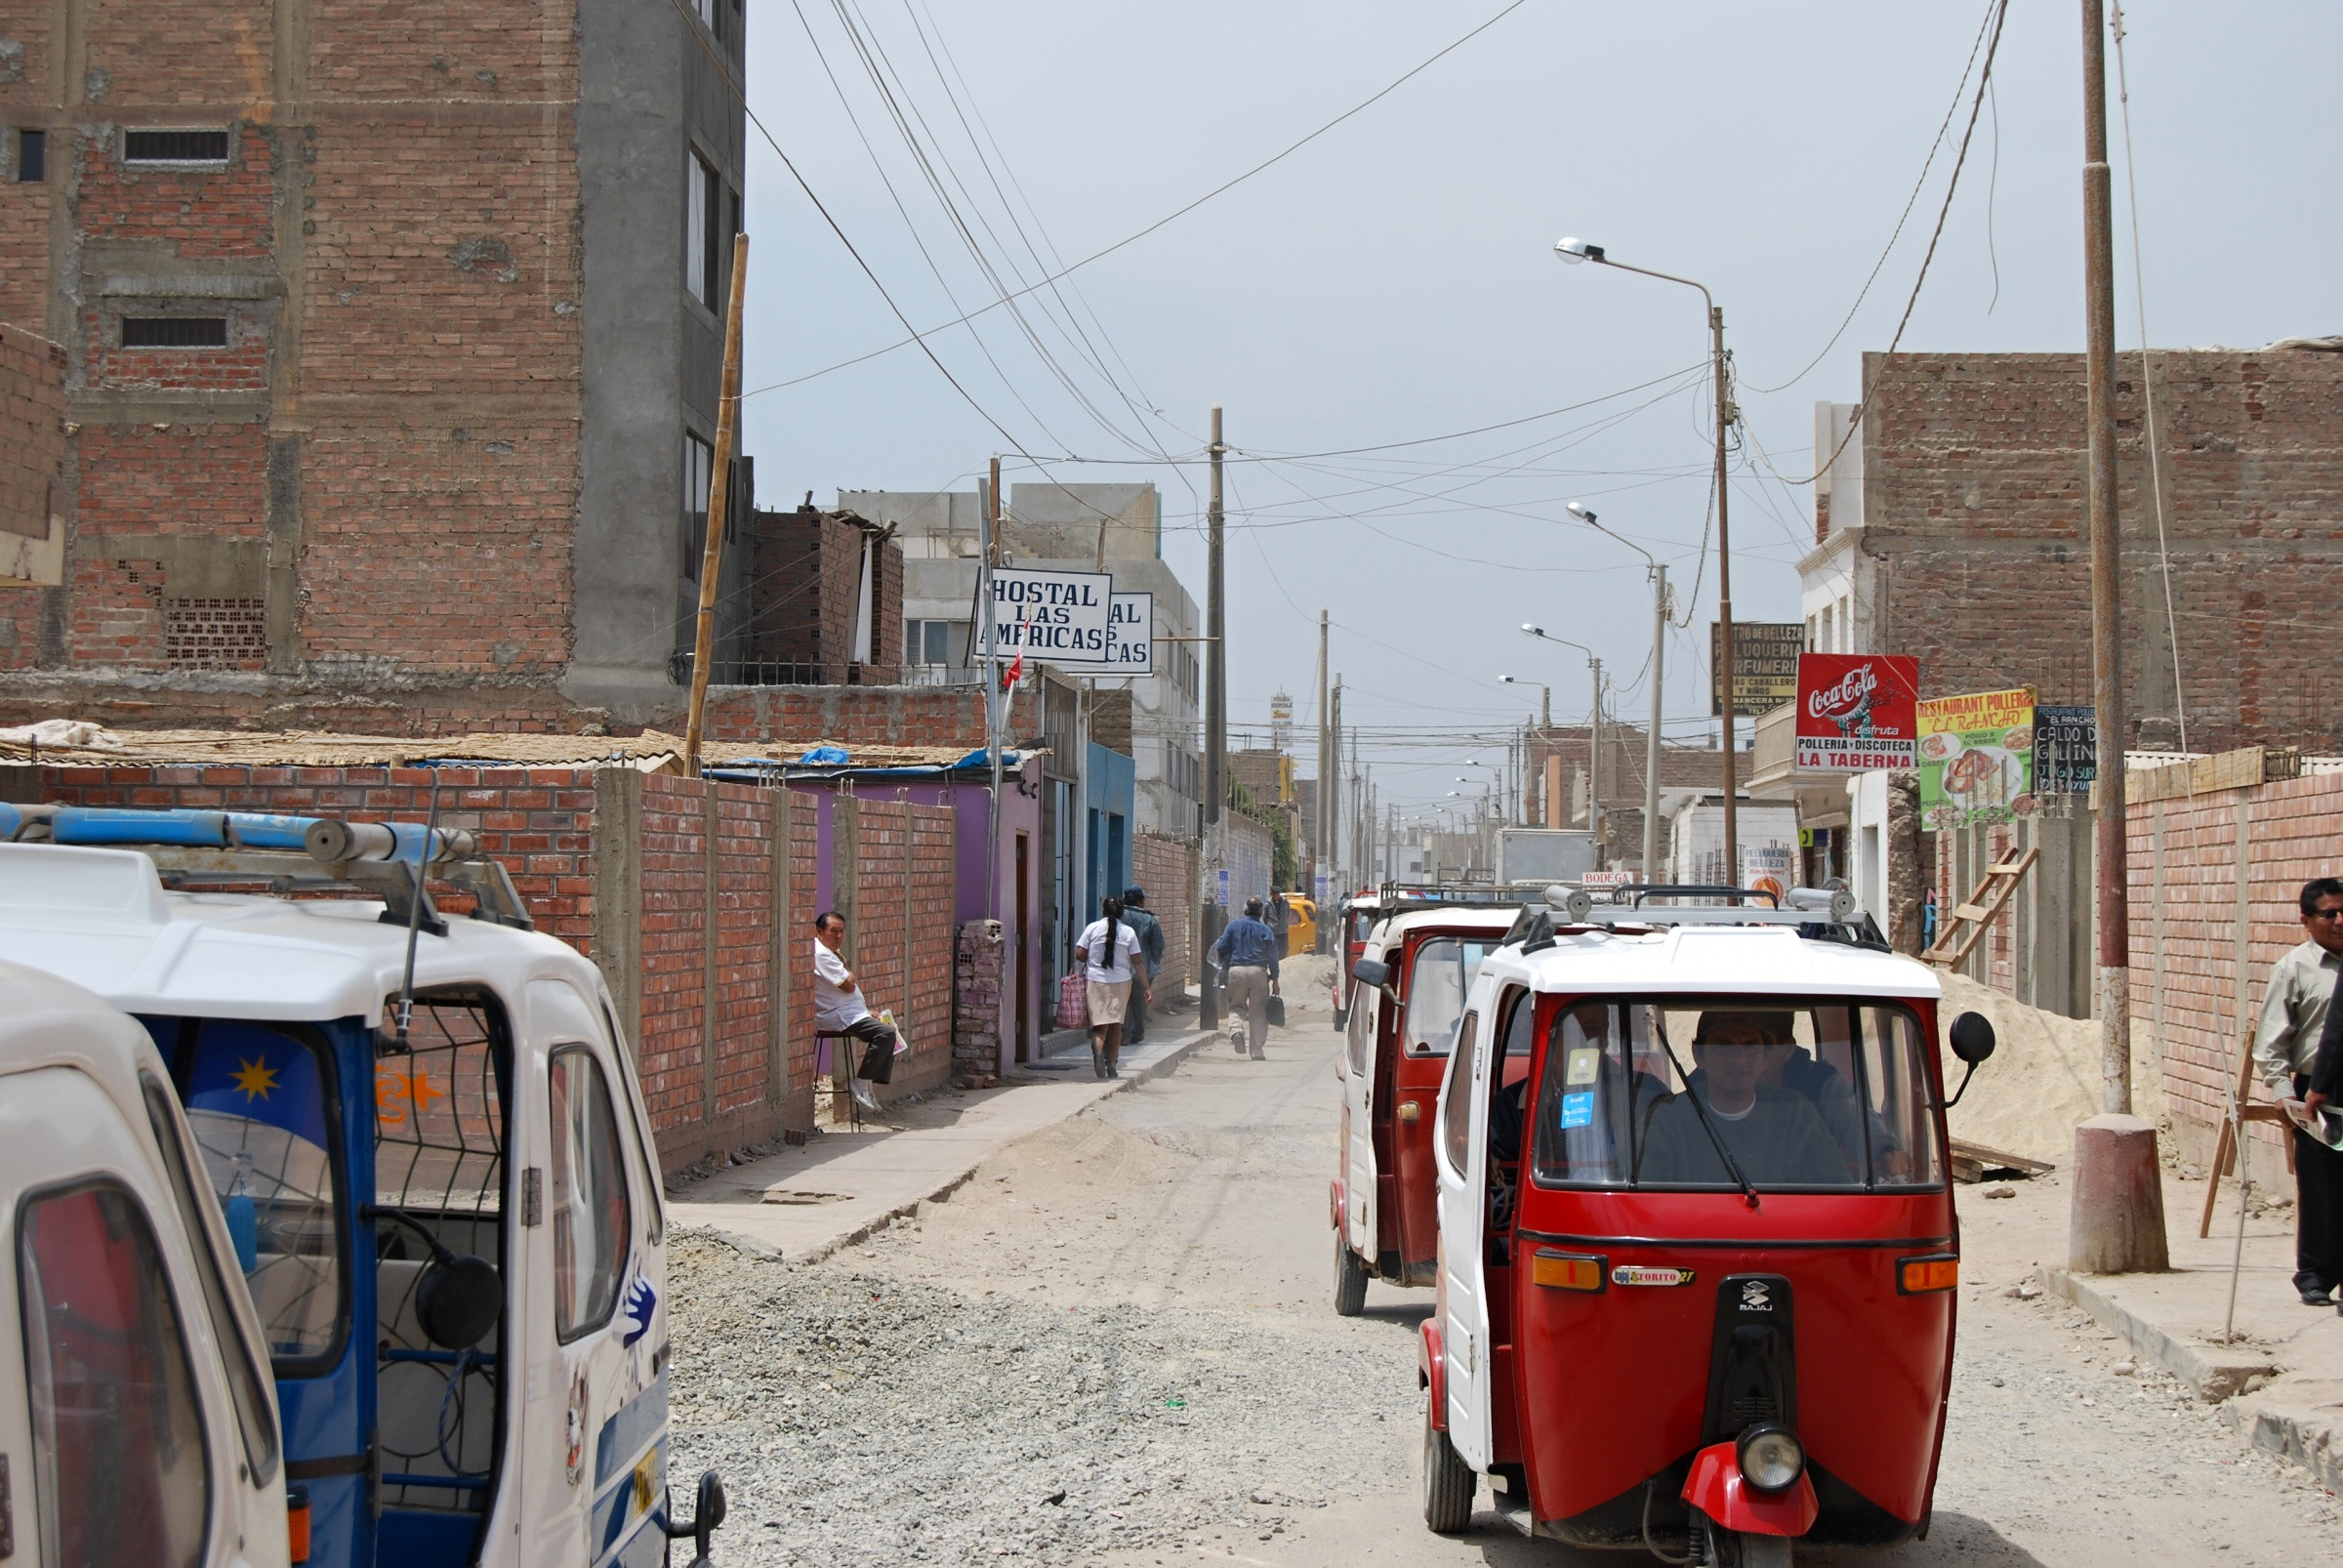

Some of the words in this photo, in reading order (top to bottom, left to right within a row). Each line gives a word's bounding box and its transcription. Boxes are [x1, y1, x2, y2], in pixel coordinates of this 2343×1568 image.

[993, 580, 1097, 607] HOSTAL
[1015, 605, 1070, 624] LAS
[1110, 603, 1141, 624] AL
[1764, 626, 1803, 641] BELLEZA
[1106, 643, 1147, 663] CAS
[1715, 643, 1802, 657] PLUQUERIA
[1716, 660, 1797, 674] PRFUMERI
[1808, 662, 1877, 719] Coca-Cola
[1917, 696, 1983, 718] RESTAURANT
[1854, 724, 1900, 736] disfruta
[2036, 726, 2080, 741] CALDO
[2087, 726, 2096, 742] D
[1798, 738, 1848, 750] POLLERIA
[1855, 740, 1912, 752] DISCOTECA
[1798, 752, 1821, 766] LA
[1829, 752, 1911, 768] TABERNA
[1585, 873, 1628, 884] BODEGA
[1638, 1272, 1676, 1282] TORITO
[1678, 1271, 1694, 1282] 2T
